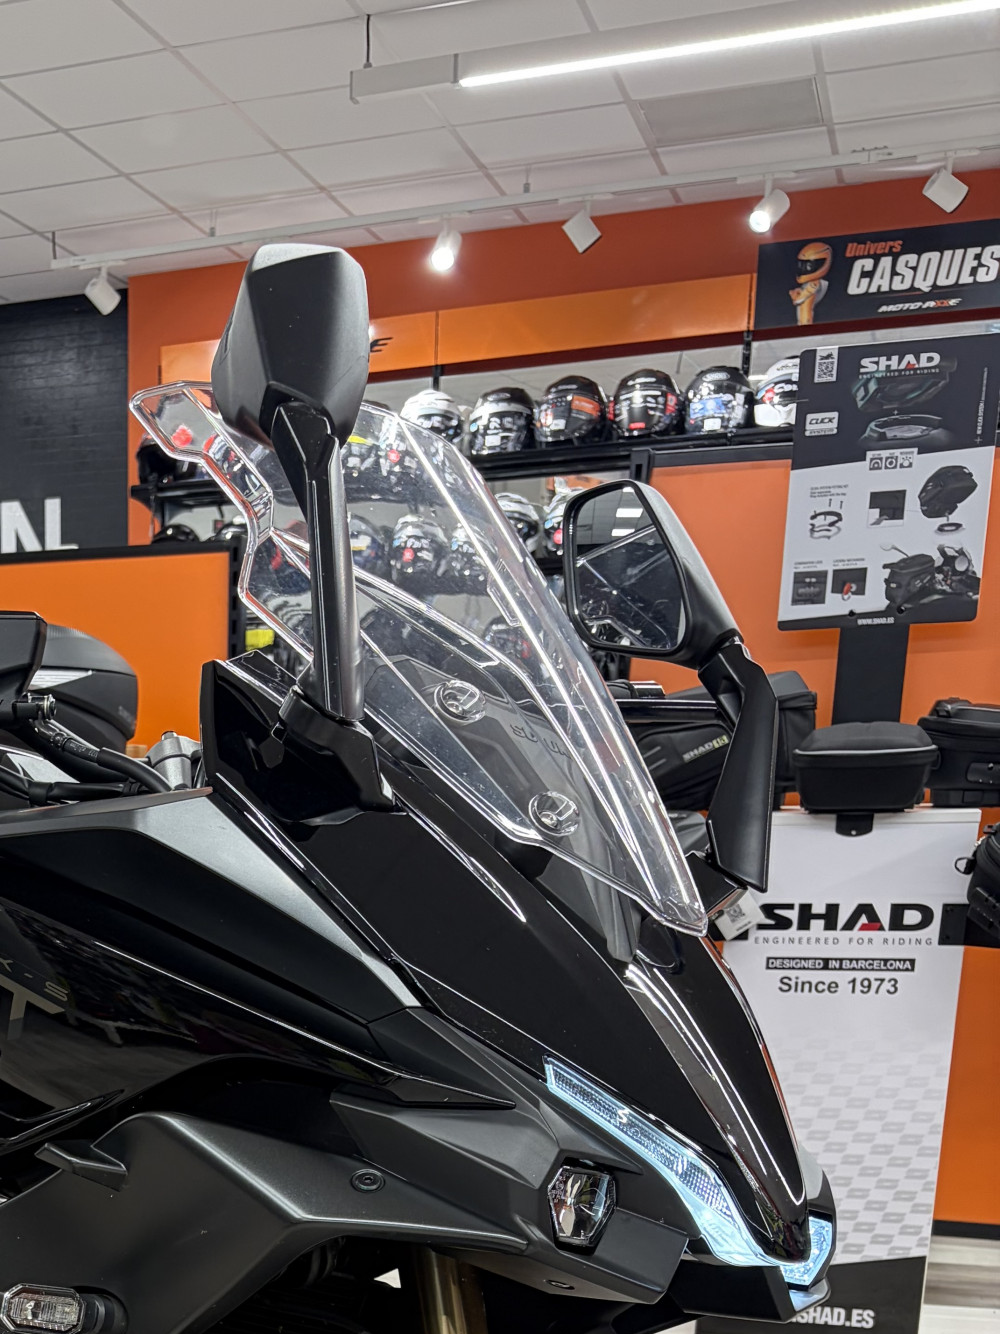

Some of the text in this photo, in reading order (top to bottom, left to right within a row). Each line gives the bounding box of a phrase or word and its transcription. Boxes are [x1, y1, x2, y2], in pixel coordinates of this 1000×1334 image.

[845, 240, 903, 258] Univers
[847, 245, 1000, 296] CASQUES
[859, 352, 941, 373] SHAD
[756, 903, 935, 931] SHAD
[753, 936, 933, 946] ENGINEERED FOR RIDING
[768, 957, 912, 970] DESIGNED IN BARCELONA
[778, 976, 899, 995] Since 1973
